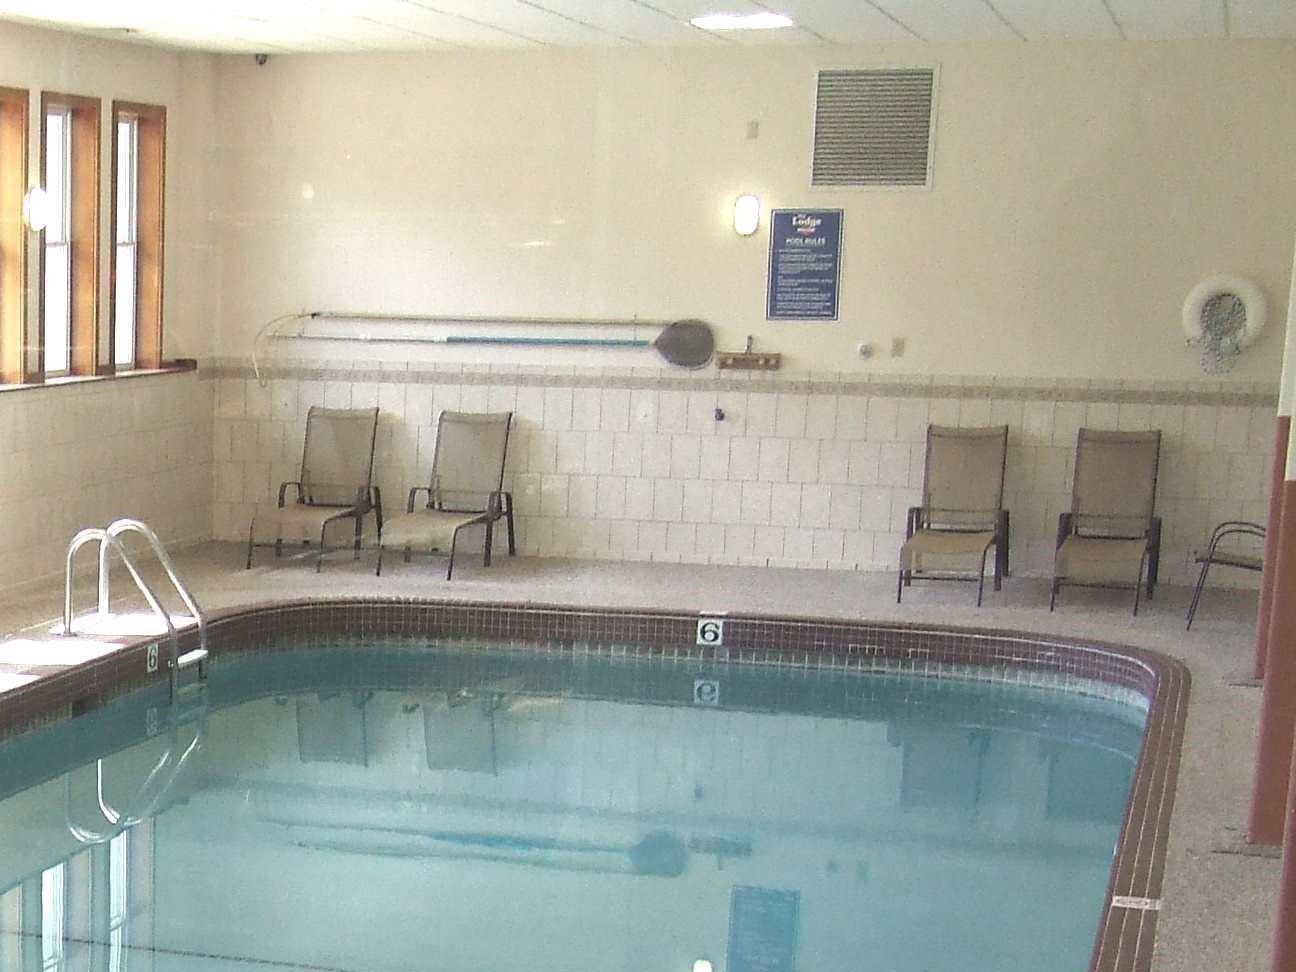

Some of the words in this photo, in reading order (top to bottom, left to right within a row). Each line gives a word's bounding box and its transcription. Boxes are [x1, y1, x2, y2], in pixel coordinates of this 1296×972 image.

[792, 216, 822, 228] Lodge
[700, 622, 719, 642] 6
[148, 645, 157, 669] 6
